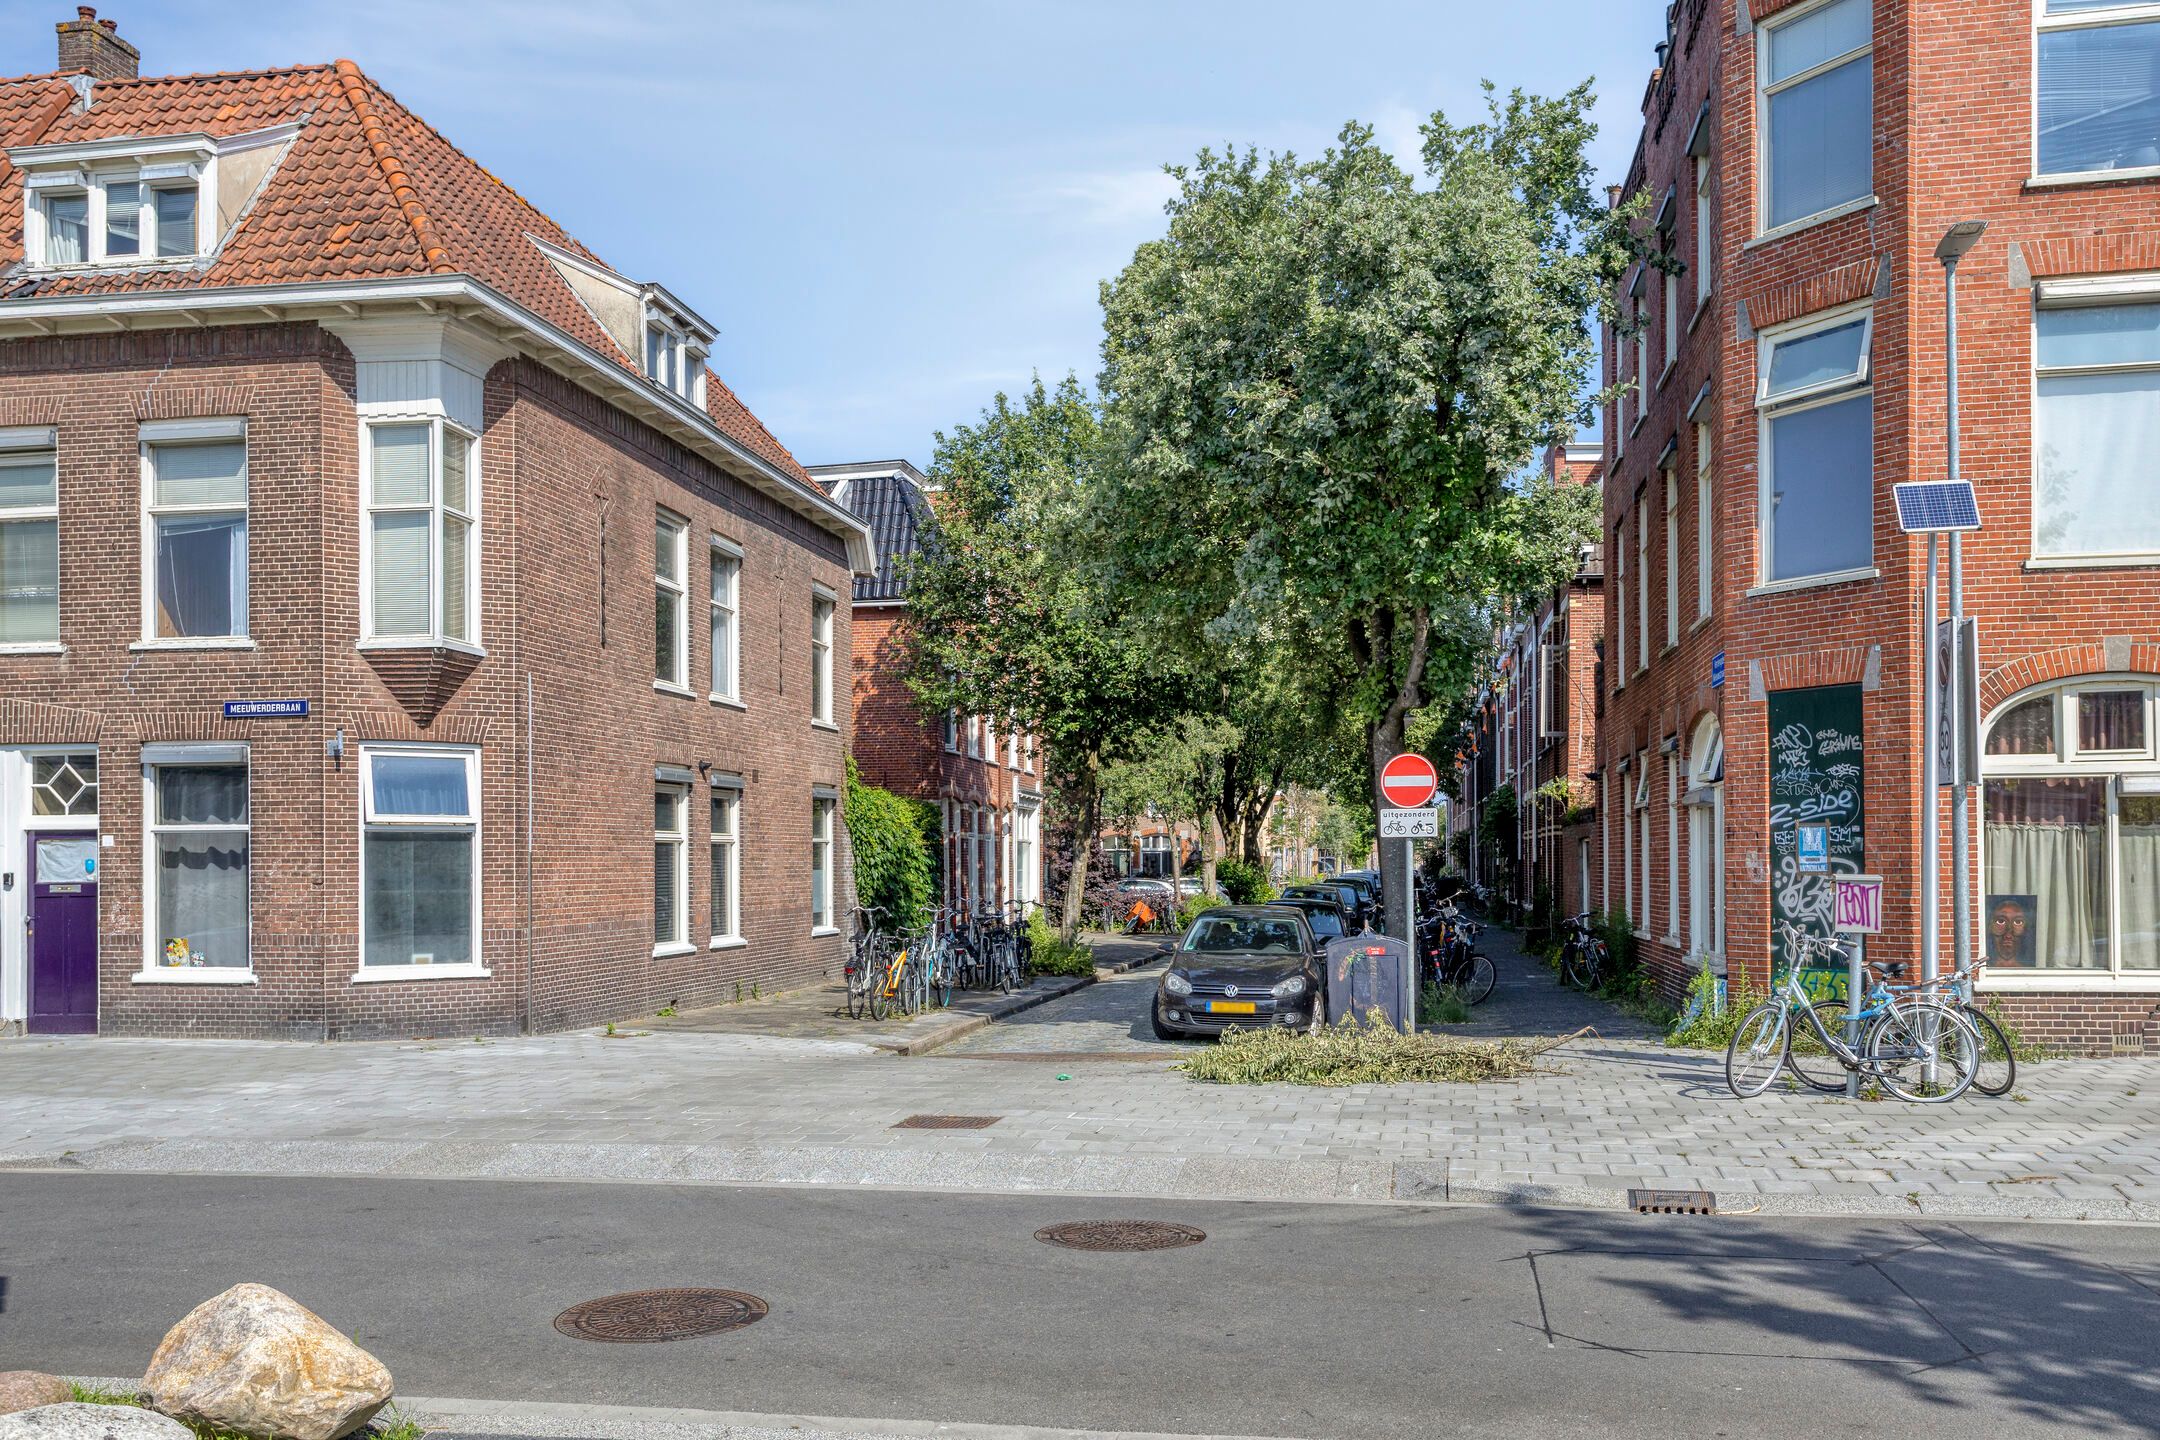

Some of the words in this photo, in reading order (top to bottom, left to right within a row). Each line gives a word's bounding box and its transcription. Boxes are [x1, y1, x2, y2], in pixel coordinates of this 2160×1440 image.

[230, 703, 301, 713] MEEUWERDERBAAN
[1940, 731, 1949, 751] 30
[1383, 811, 1435, 819] uitgezonderd
